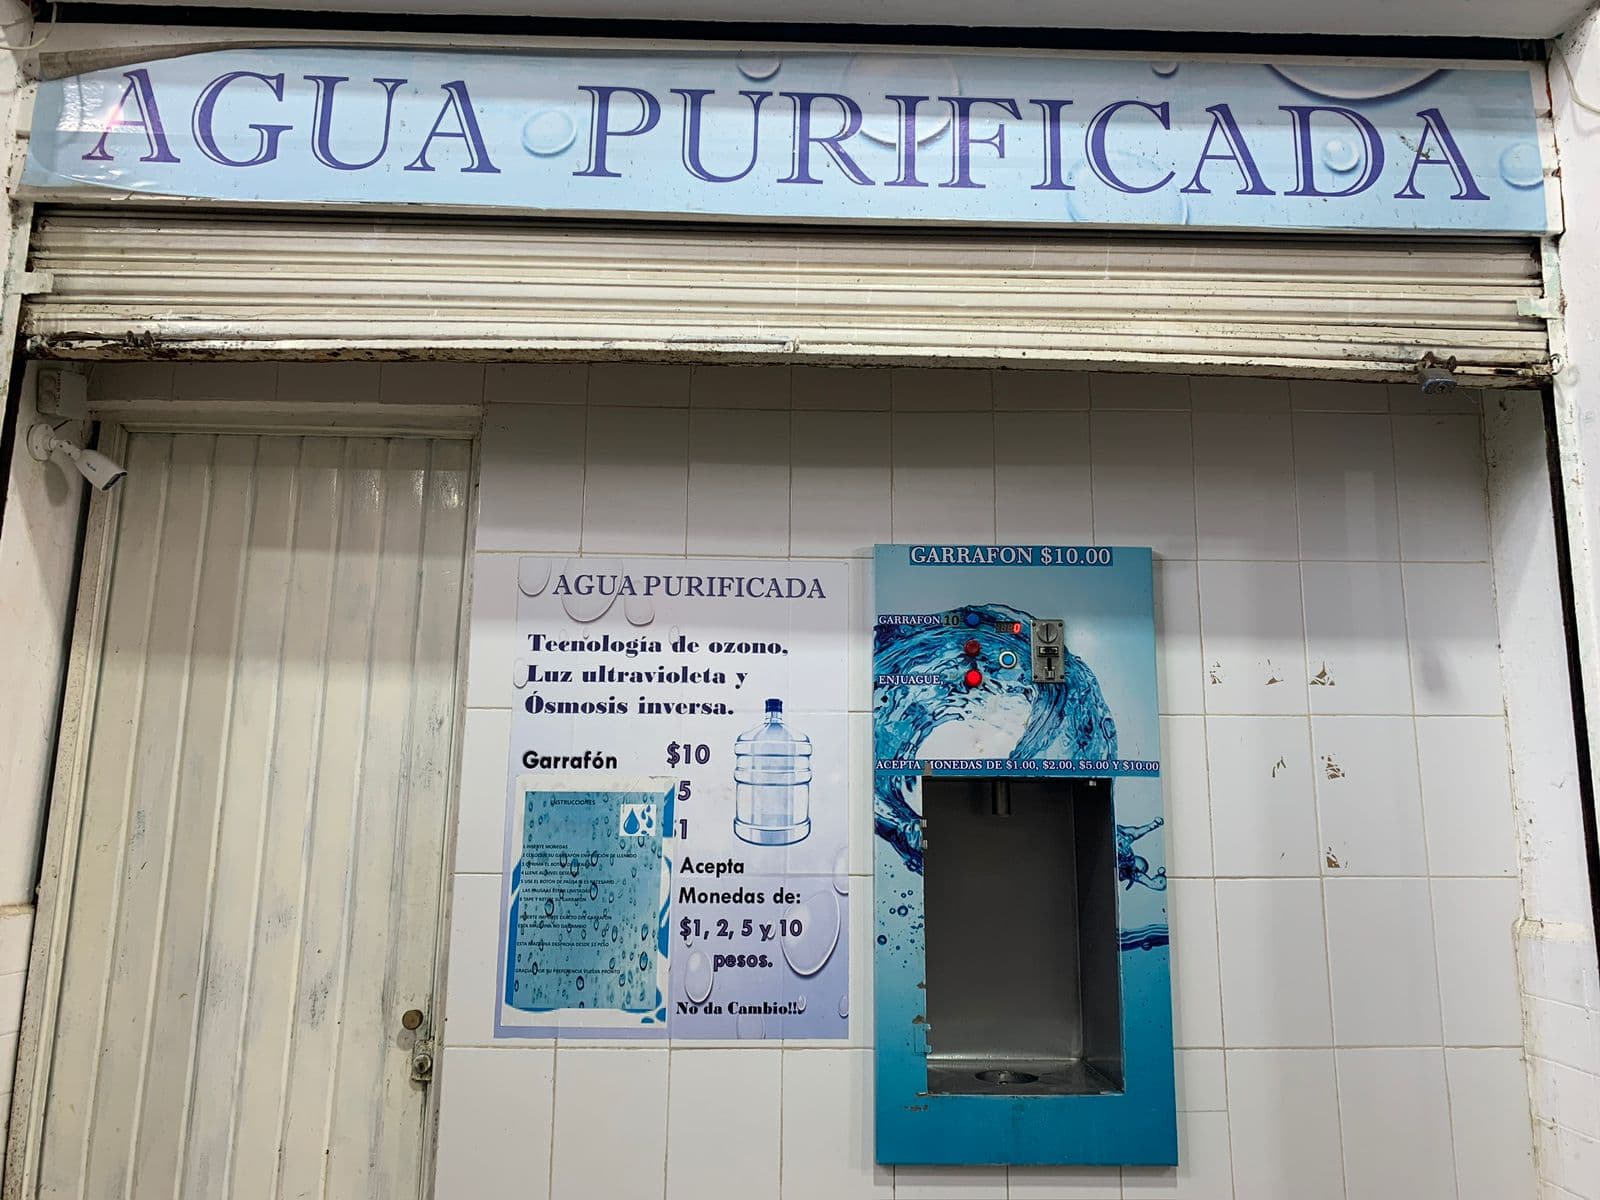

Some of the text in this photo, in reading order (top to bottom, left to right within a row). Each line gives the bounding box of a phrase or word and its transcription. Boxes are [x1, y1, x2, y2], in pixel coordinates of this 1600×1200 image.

[82, 67, 1491, 202] AGUA PURIFICADA
[910, 546, 1112, 566] GARRAFON $10.00
[553, 574, 827, 599] AGUA PURIFICADA
[878, 614, 960, 626] GARRAFON 10
[527, 633, 663, 659] Tecnología
[671, 634, 700, 655] de
[526, 664, 749, 690] Luz ultravioleta y
[525, 690, 735, 716] Ósmosis inversa.
[522, 749, 618, 770] Garrafón
[666, 741, 710, 769] $10
[876, 760, 921, 770] ACEPTA
[986, 760, 1003, 770] DE
[1005, 760, 1040, 772] $1.00,
[1042, 761, 1077, 773] $2.00,
[1078, 761, 1110, 772] $5.00
[1112, 761, 1122, 771] Y
[1122, 761, 1160, 772] $10.00
[680, 856, 745, 878] Acepta
[678, 886, 802, 905] Monedas de:
[679, 916, 803, 942] $1, 2, 5 y 10
[713, 954, 774, 972] pesos.
[676, 1001, 699, 1015] No
[703, 1001, 723, 1015] da
